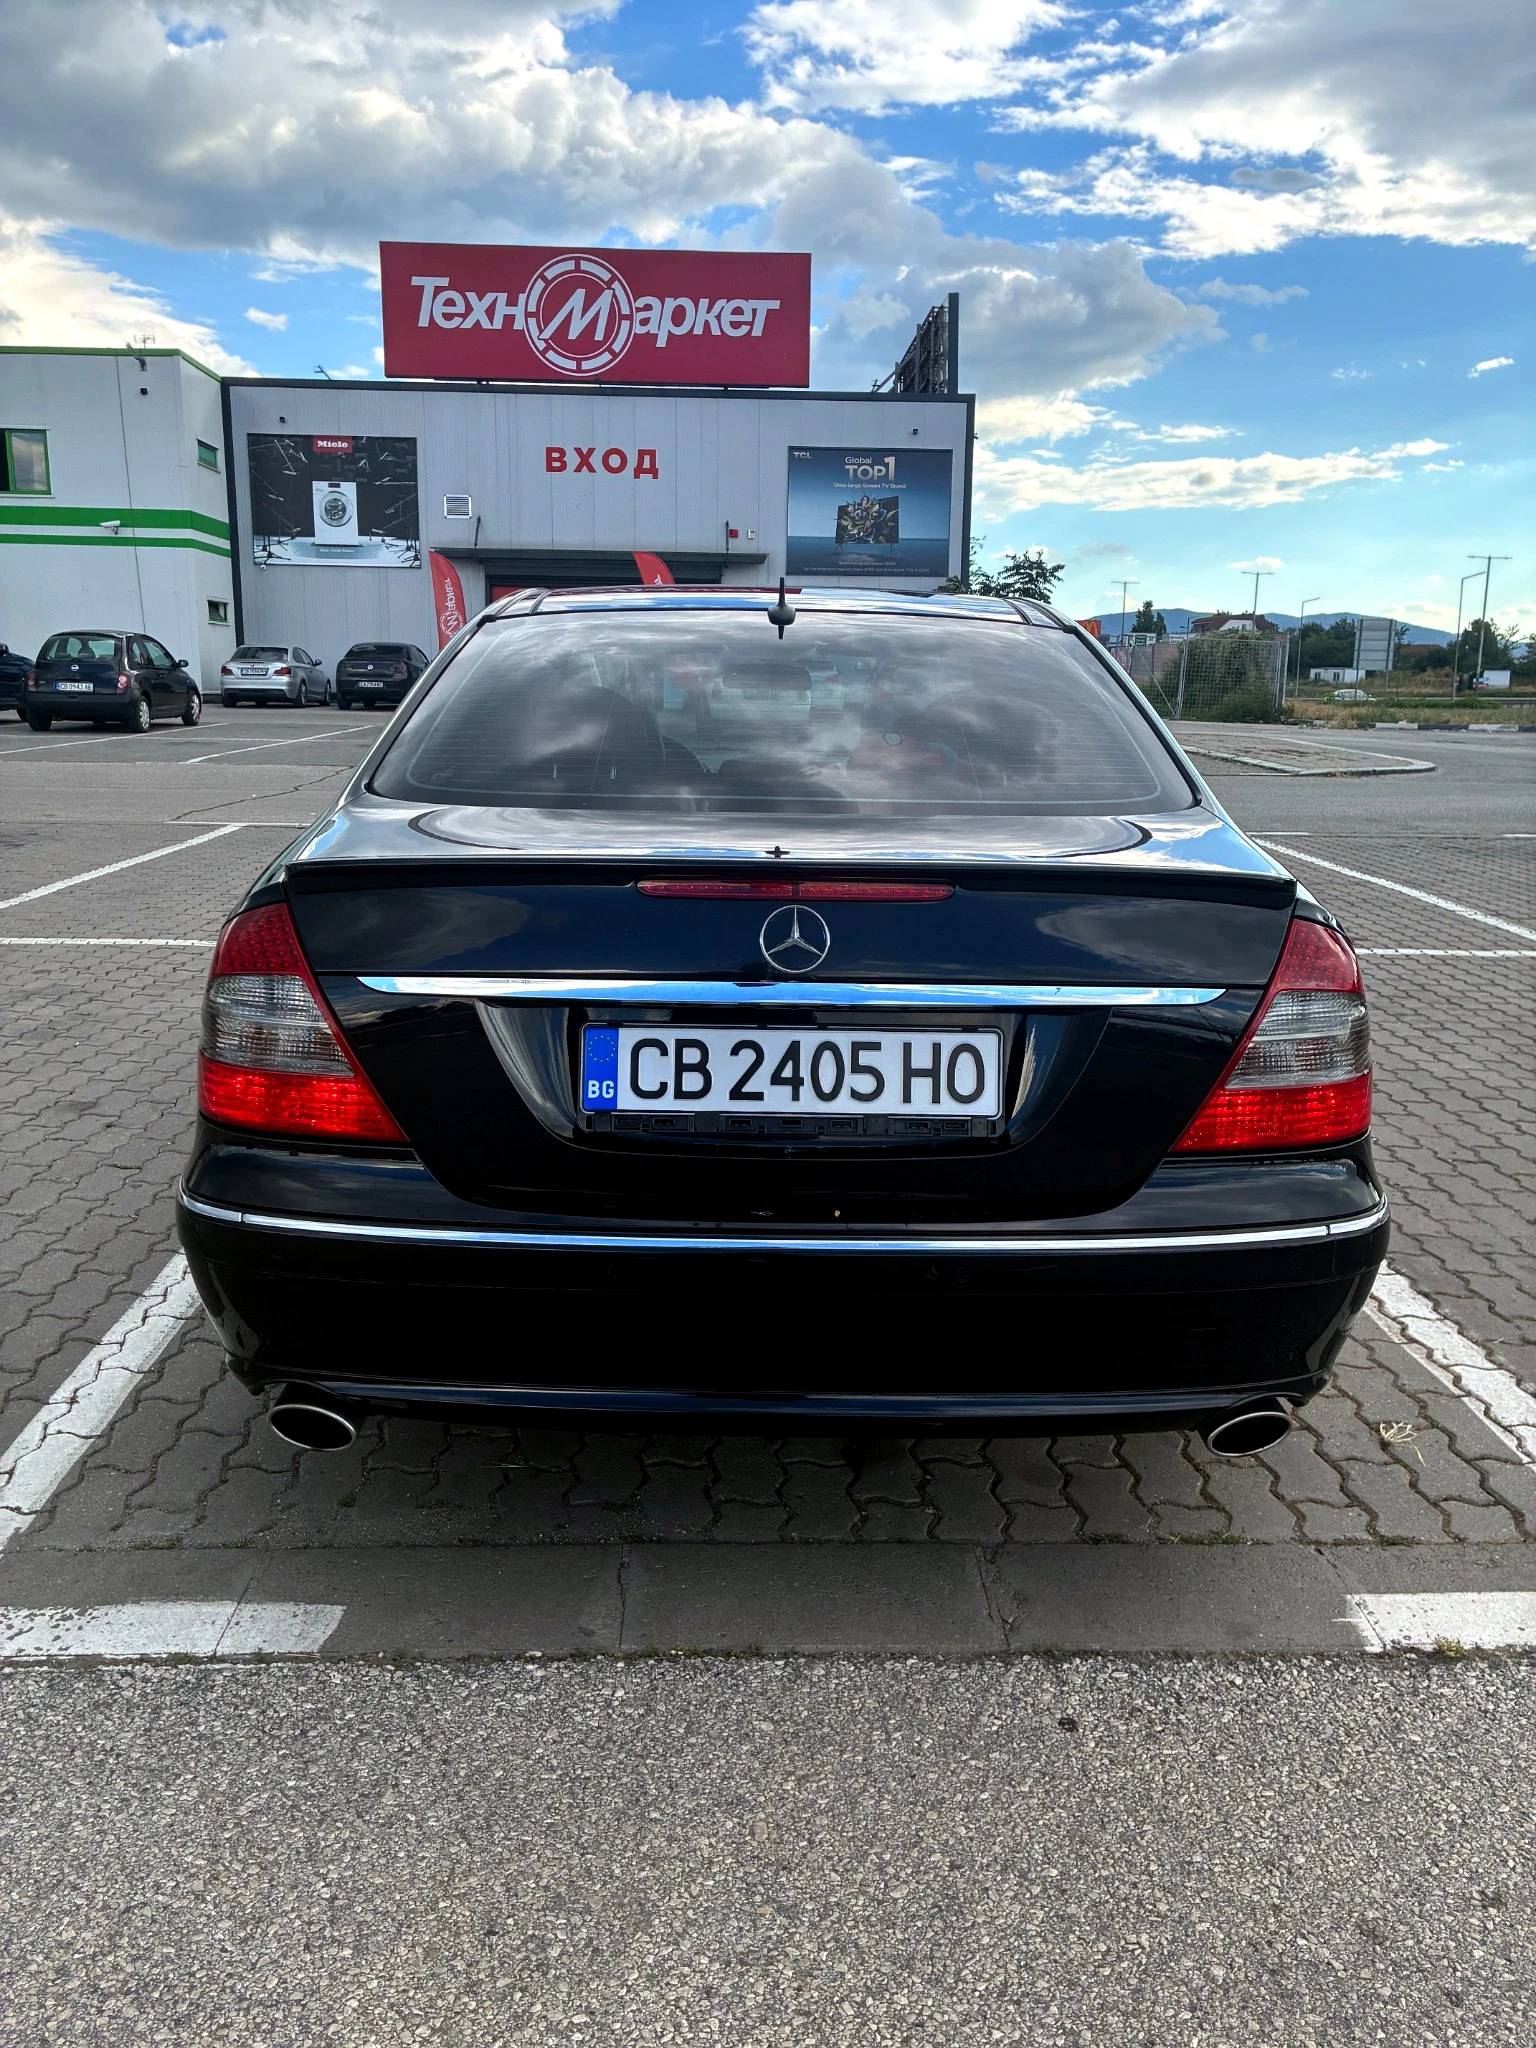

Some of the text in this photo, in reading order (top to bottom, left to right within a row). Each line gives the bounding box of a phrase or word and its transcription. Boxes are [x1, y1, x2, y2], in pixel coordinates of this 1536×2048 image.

[317, 440, 348, 448] Miele
[545, 446, 659, 479] ВХОД
[845, 456, 872, 464] Global
[629, 1038, 986, 1104] CB 2405 HO
[587, 1079, 615, 1099] BG
